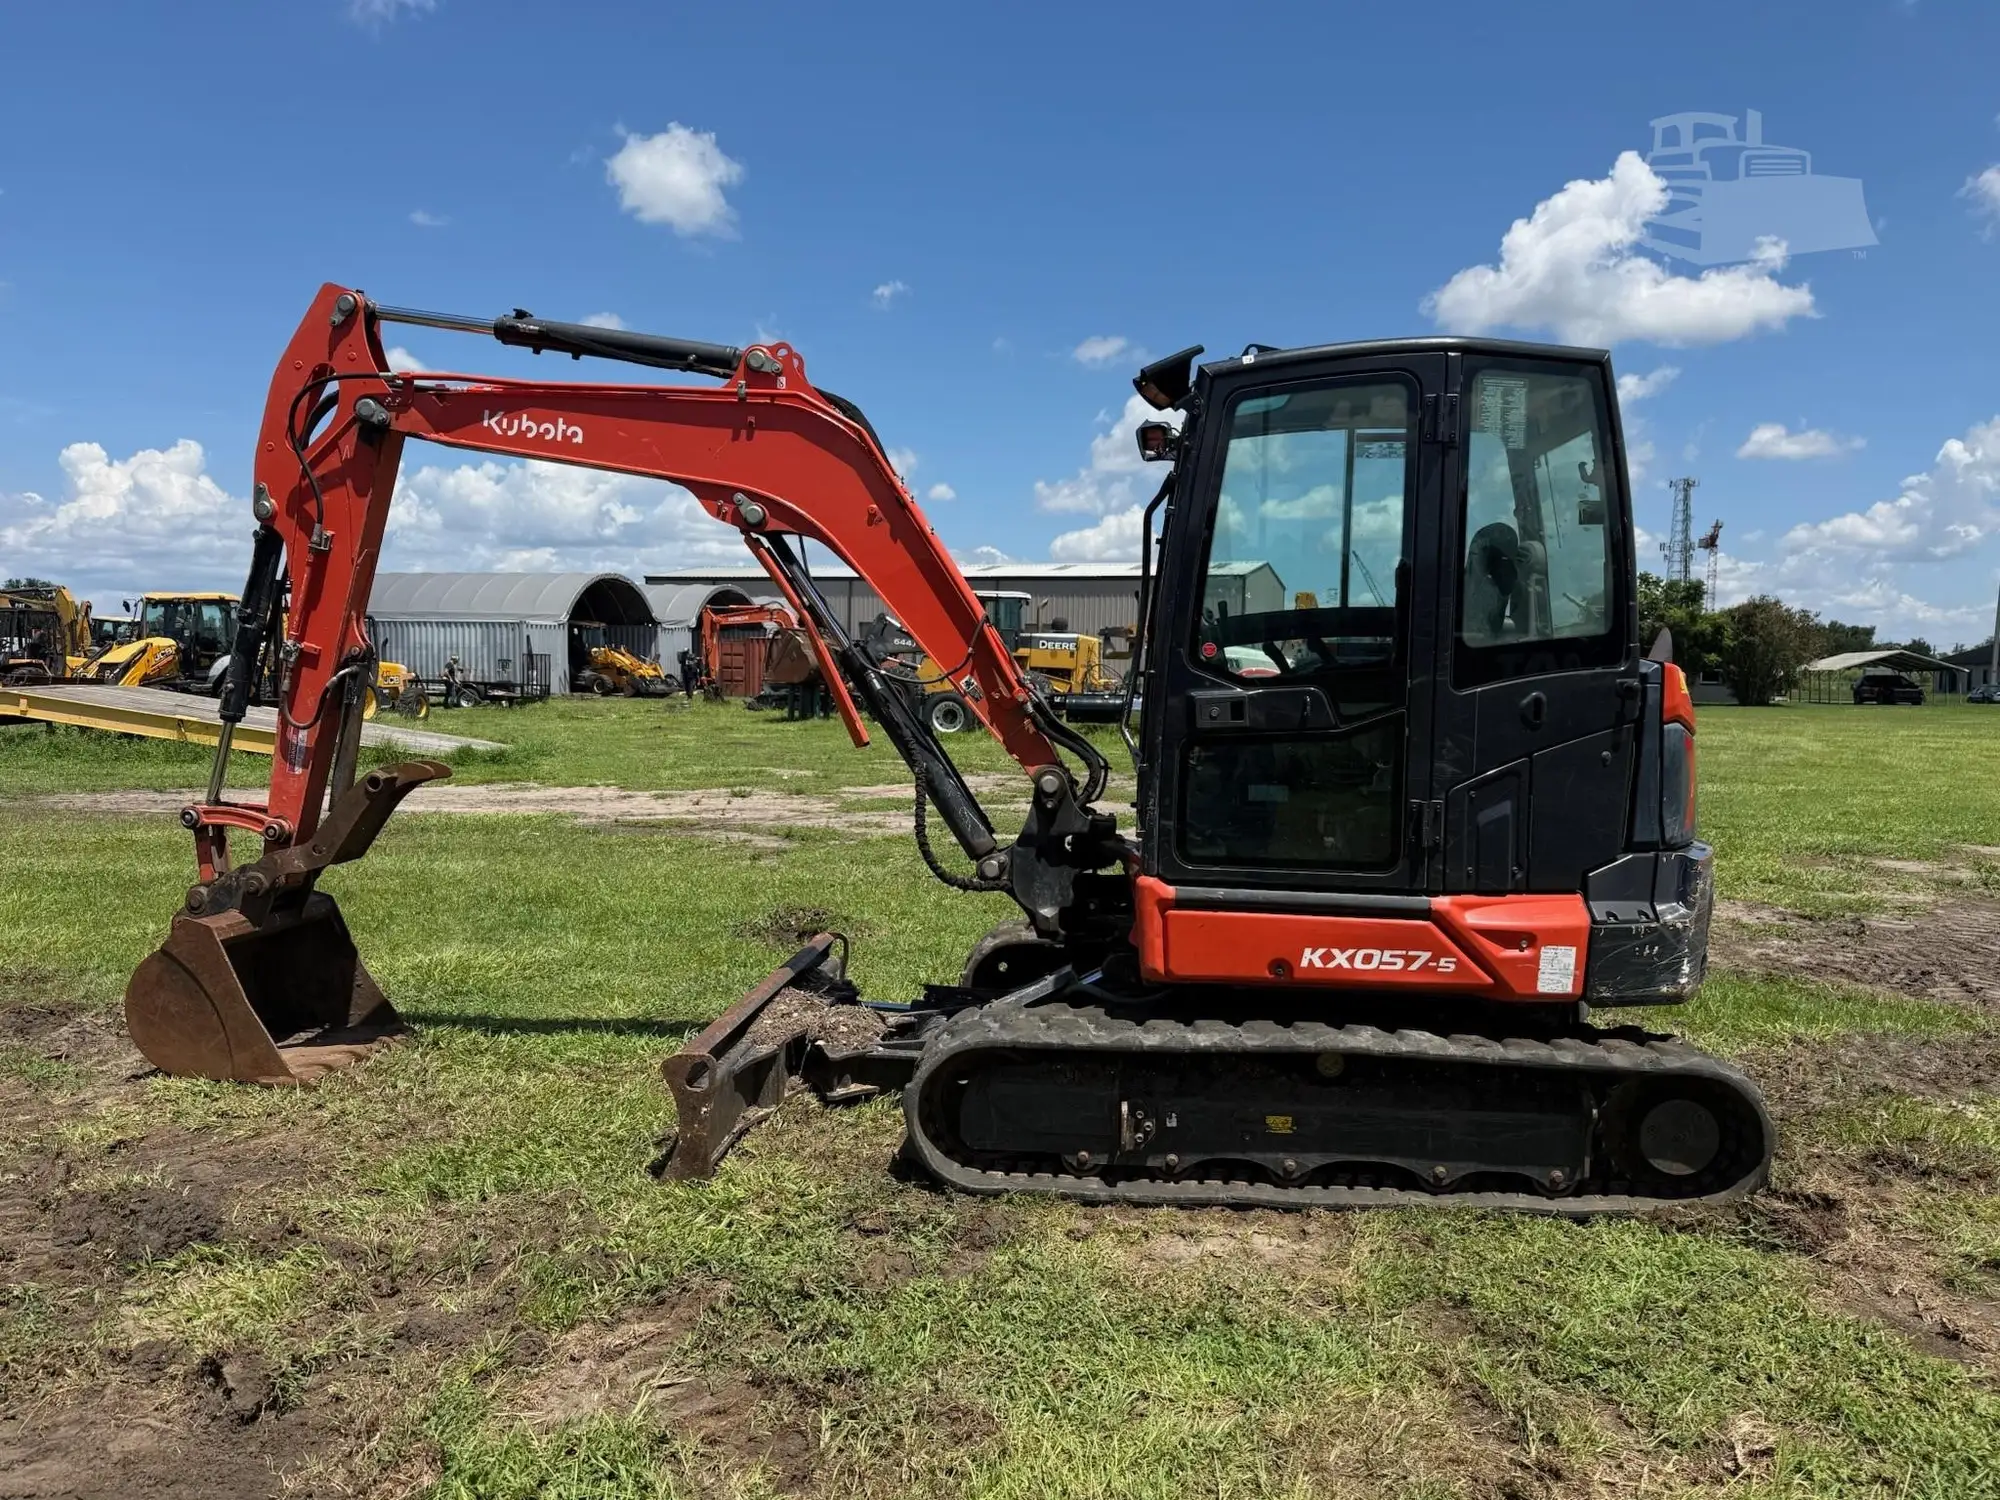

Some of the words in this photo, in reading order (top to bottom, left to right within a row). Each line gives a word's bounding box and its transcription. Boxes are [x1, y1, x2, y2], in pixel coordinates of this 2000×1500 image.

[483, 410, 583, 444] Kubota
[1039, 640, 1077, 650] DEERE
[154, 646, 173, 661] JCB
[383, 676, 399, 685] JCB
[1300, 948, 1457, 972] KX057-5
